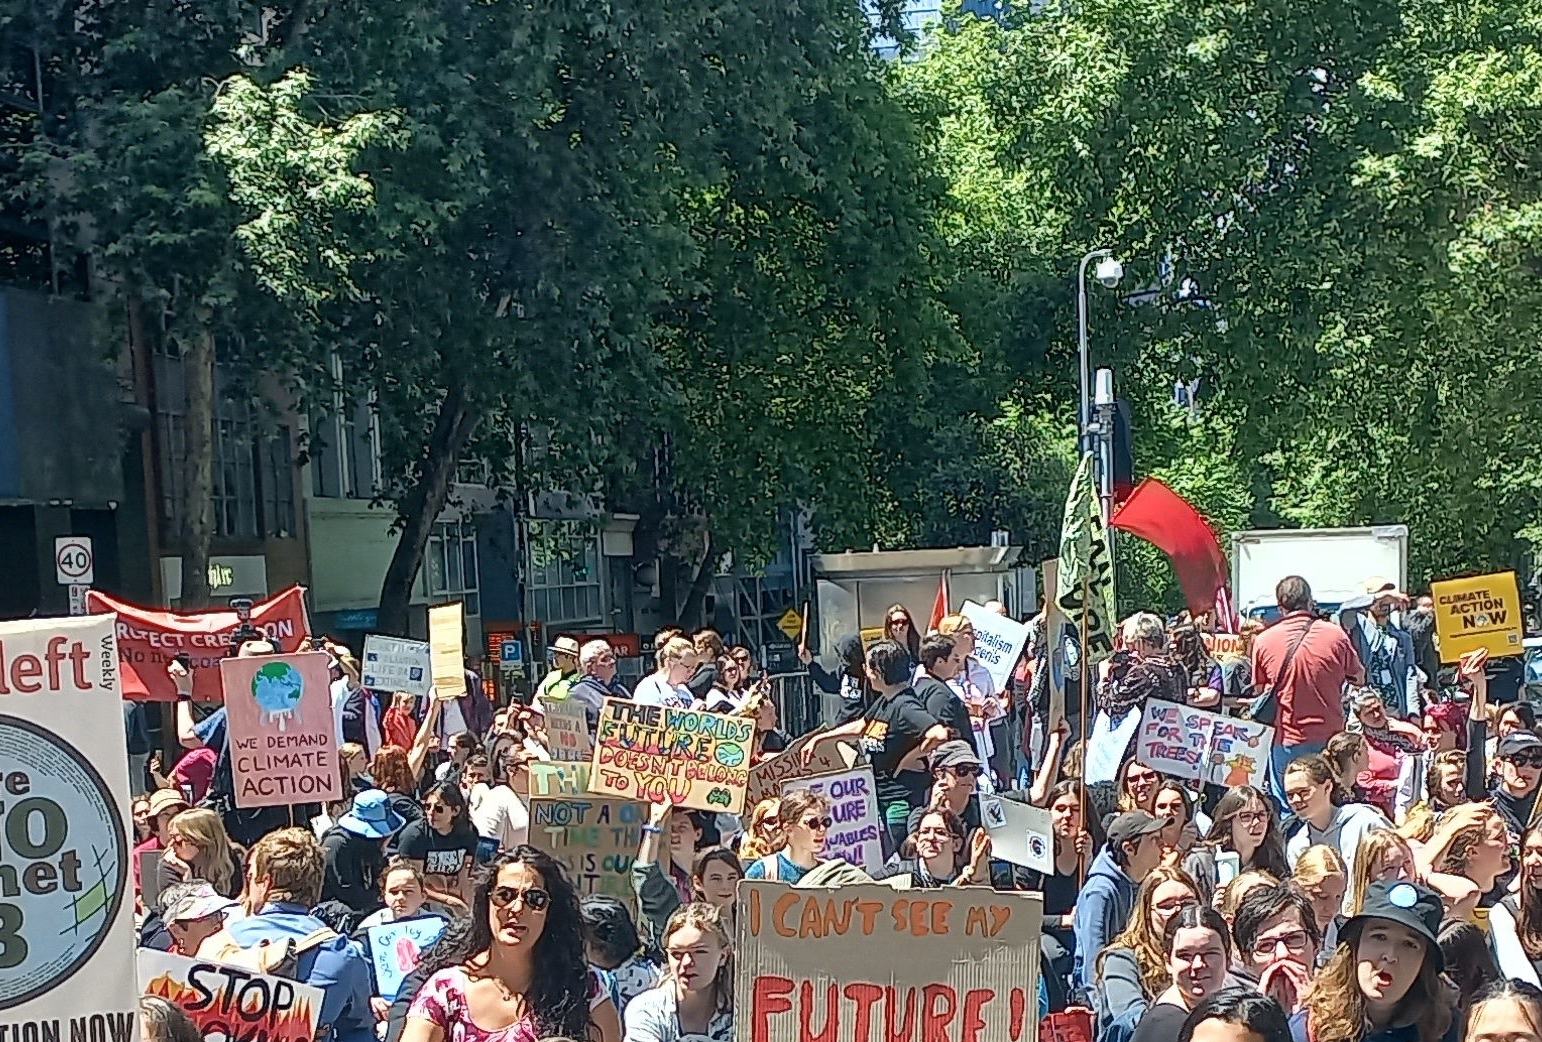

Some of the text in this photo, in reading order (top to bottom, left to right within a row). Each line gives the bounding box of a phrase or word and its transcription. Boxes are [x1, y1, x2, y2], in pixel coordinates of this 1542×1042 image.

[61, 551, 88, 569] 40
[1439, 590, 1490, 605] CLIMATE
[1450, 598, 1504, 616] ACTION
[100, 634, 116, 692] Weekly
[505, 645, 516, 659] P
[608, 701, 661, 727] THE
[665, 708, 752, 742] WORLD'S
[1151, 705, 1178, 724] WE
[236, 734, 329, 751] WE DEMAND
[599, 720, 712, 762] FUTURE
[1145, 722, 1184, 743] FOR
[238, 751, 329, 773] CLIMATE
[686, 760, 748, 788] BELONG
[241, 775, 333, 798] ACTION
[601, 769, 692, 805] TO YOU
[830, 777, 871, 800] OUR
[535, 802, 610, 826] NOT A
[544, 826, 599, 850] TIME
[750, 888, 1012, 939] I CAN'T SEE MY
[184, 963, 295, 1031] STOP
